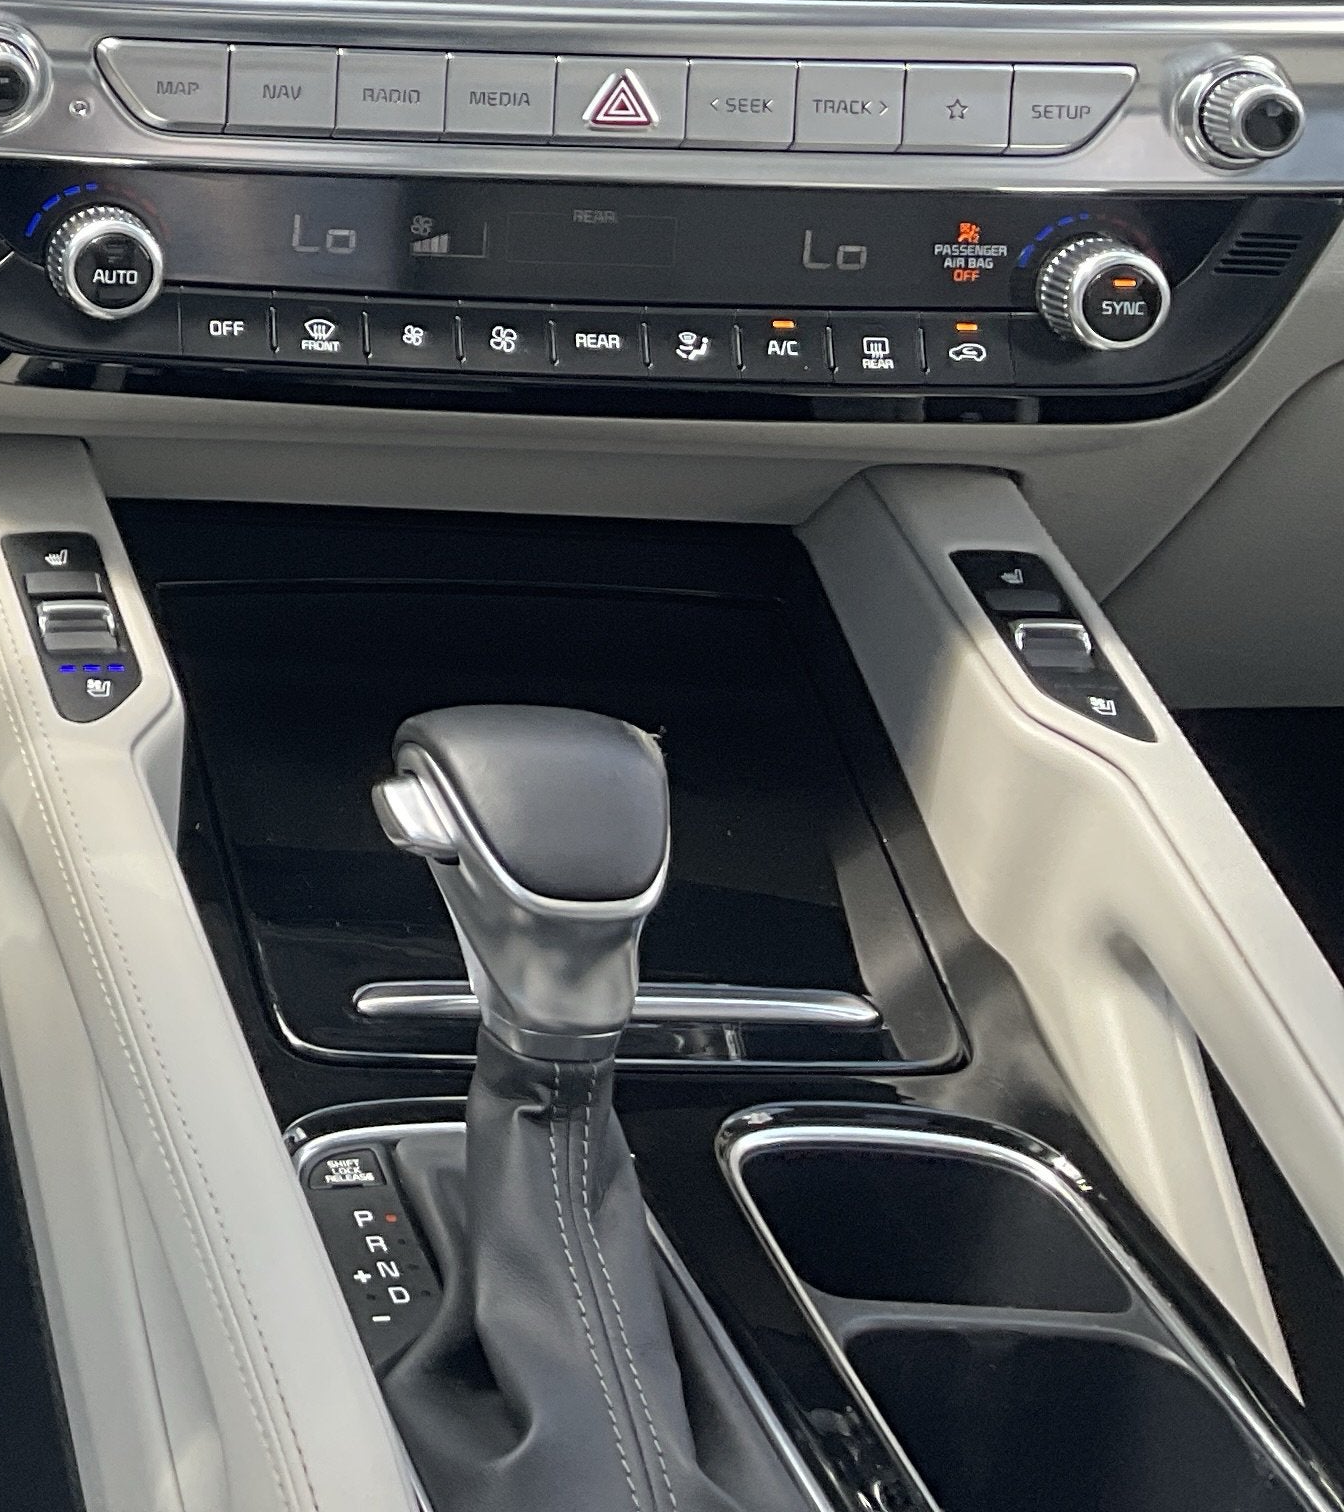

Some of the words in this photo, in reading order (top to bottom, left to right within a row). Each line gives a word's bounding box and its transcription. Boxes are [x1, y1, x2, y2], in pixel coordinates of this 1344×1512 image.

[156, 81, 200, 96] MAP
[262, 85, 302, 100] NAV
[363, 88, 421, 104] RADIO
[469, 91, 531, 107] MEDIA
[725, 97, 773, 114] SEEK
[812, 98, 872, 115] TRACK
[1031, 104, 1091, 120] SETUP
[572, 209, 617, 224] REAR
[291, 214, 357, 254] Lo
[801, 229, 868, 271] Lo
[934, 244, 1008, 257] PASSENGER
[943, 257, 965, 268] AIR
[968, 257, 994, 269] BAG
[92, 268, 138, 285] AUTO
[953, 269, 980, 282] OFF
[1101, 300, 1146, 317] SYNC
[209, 320, 245, 336] OFF
[301, 339, 341, 352] FRONT
[575, 333, 621, 349] REAR
[768, 339, 799, 356] A/C
[862, 357, 895, 370] REAR
[326, 1158, 360, 1169] SHIFT
[331, 1166, 362, 1175] LOCK
[324, 1172, 375, 1183] RELEASE
[353, 1210, 374, 1228] P
[365, 1235, 389, 1253] R
[376, 1261, 401, 1278] N
[387, 1286, 411, 1304] D
